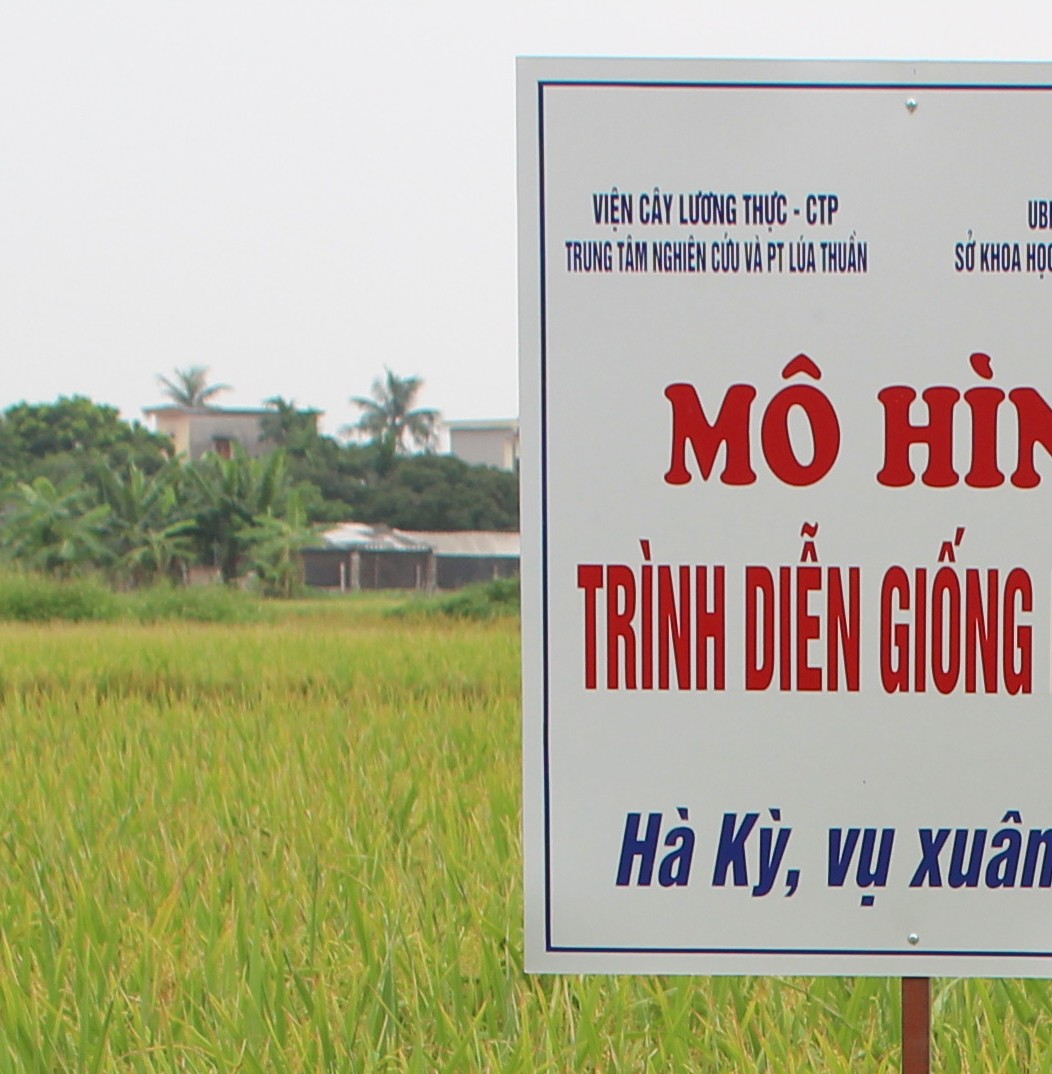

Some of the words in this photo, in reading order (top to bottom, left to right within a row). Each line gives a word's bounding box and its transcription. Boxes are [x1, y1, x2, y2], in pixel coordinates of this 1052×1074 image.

[592, 186, 633, 232] VIỆN
[638, 186, 674, 226] CÂY
[679, 190, 737, 226] LƯƠNG
[743, 190, 788, 233] THỰC
[793, 207, 800, 216] -
[805, 193, 839, 226] CTP
[565, 240, 613, 273] TRUNG
[617, 234, 648, 273] TÂM
[652, 234, 707, 273] NGHIÊN
[711, 232, 740, 273] CỨU
[744, 235, 763, 273] VÀ
[767, 241, 784, 273] PT
[788, 235, 816, 273] LÚA
[954, 229, 976, 272] SỞ
[980, 242, 1022, 273] KHOA
[663, 352, 841, 487] MÔ
[576, 539, 726, 691] TRÌNH
[744, 521, 861, 692] DIỄN
[879, 526, 1034, 695] GIỐNG
[615, 806, 697, 888] Hà
[711, 807, 802, 897] Kỳ,
[826, 827, 895, 907] vụ
